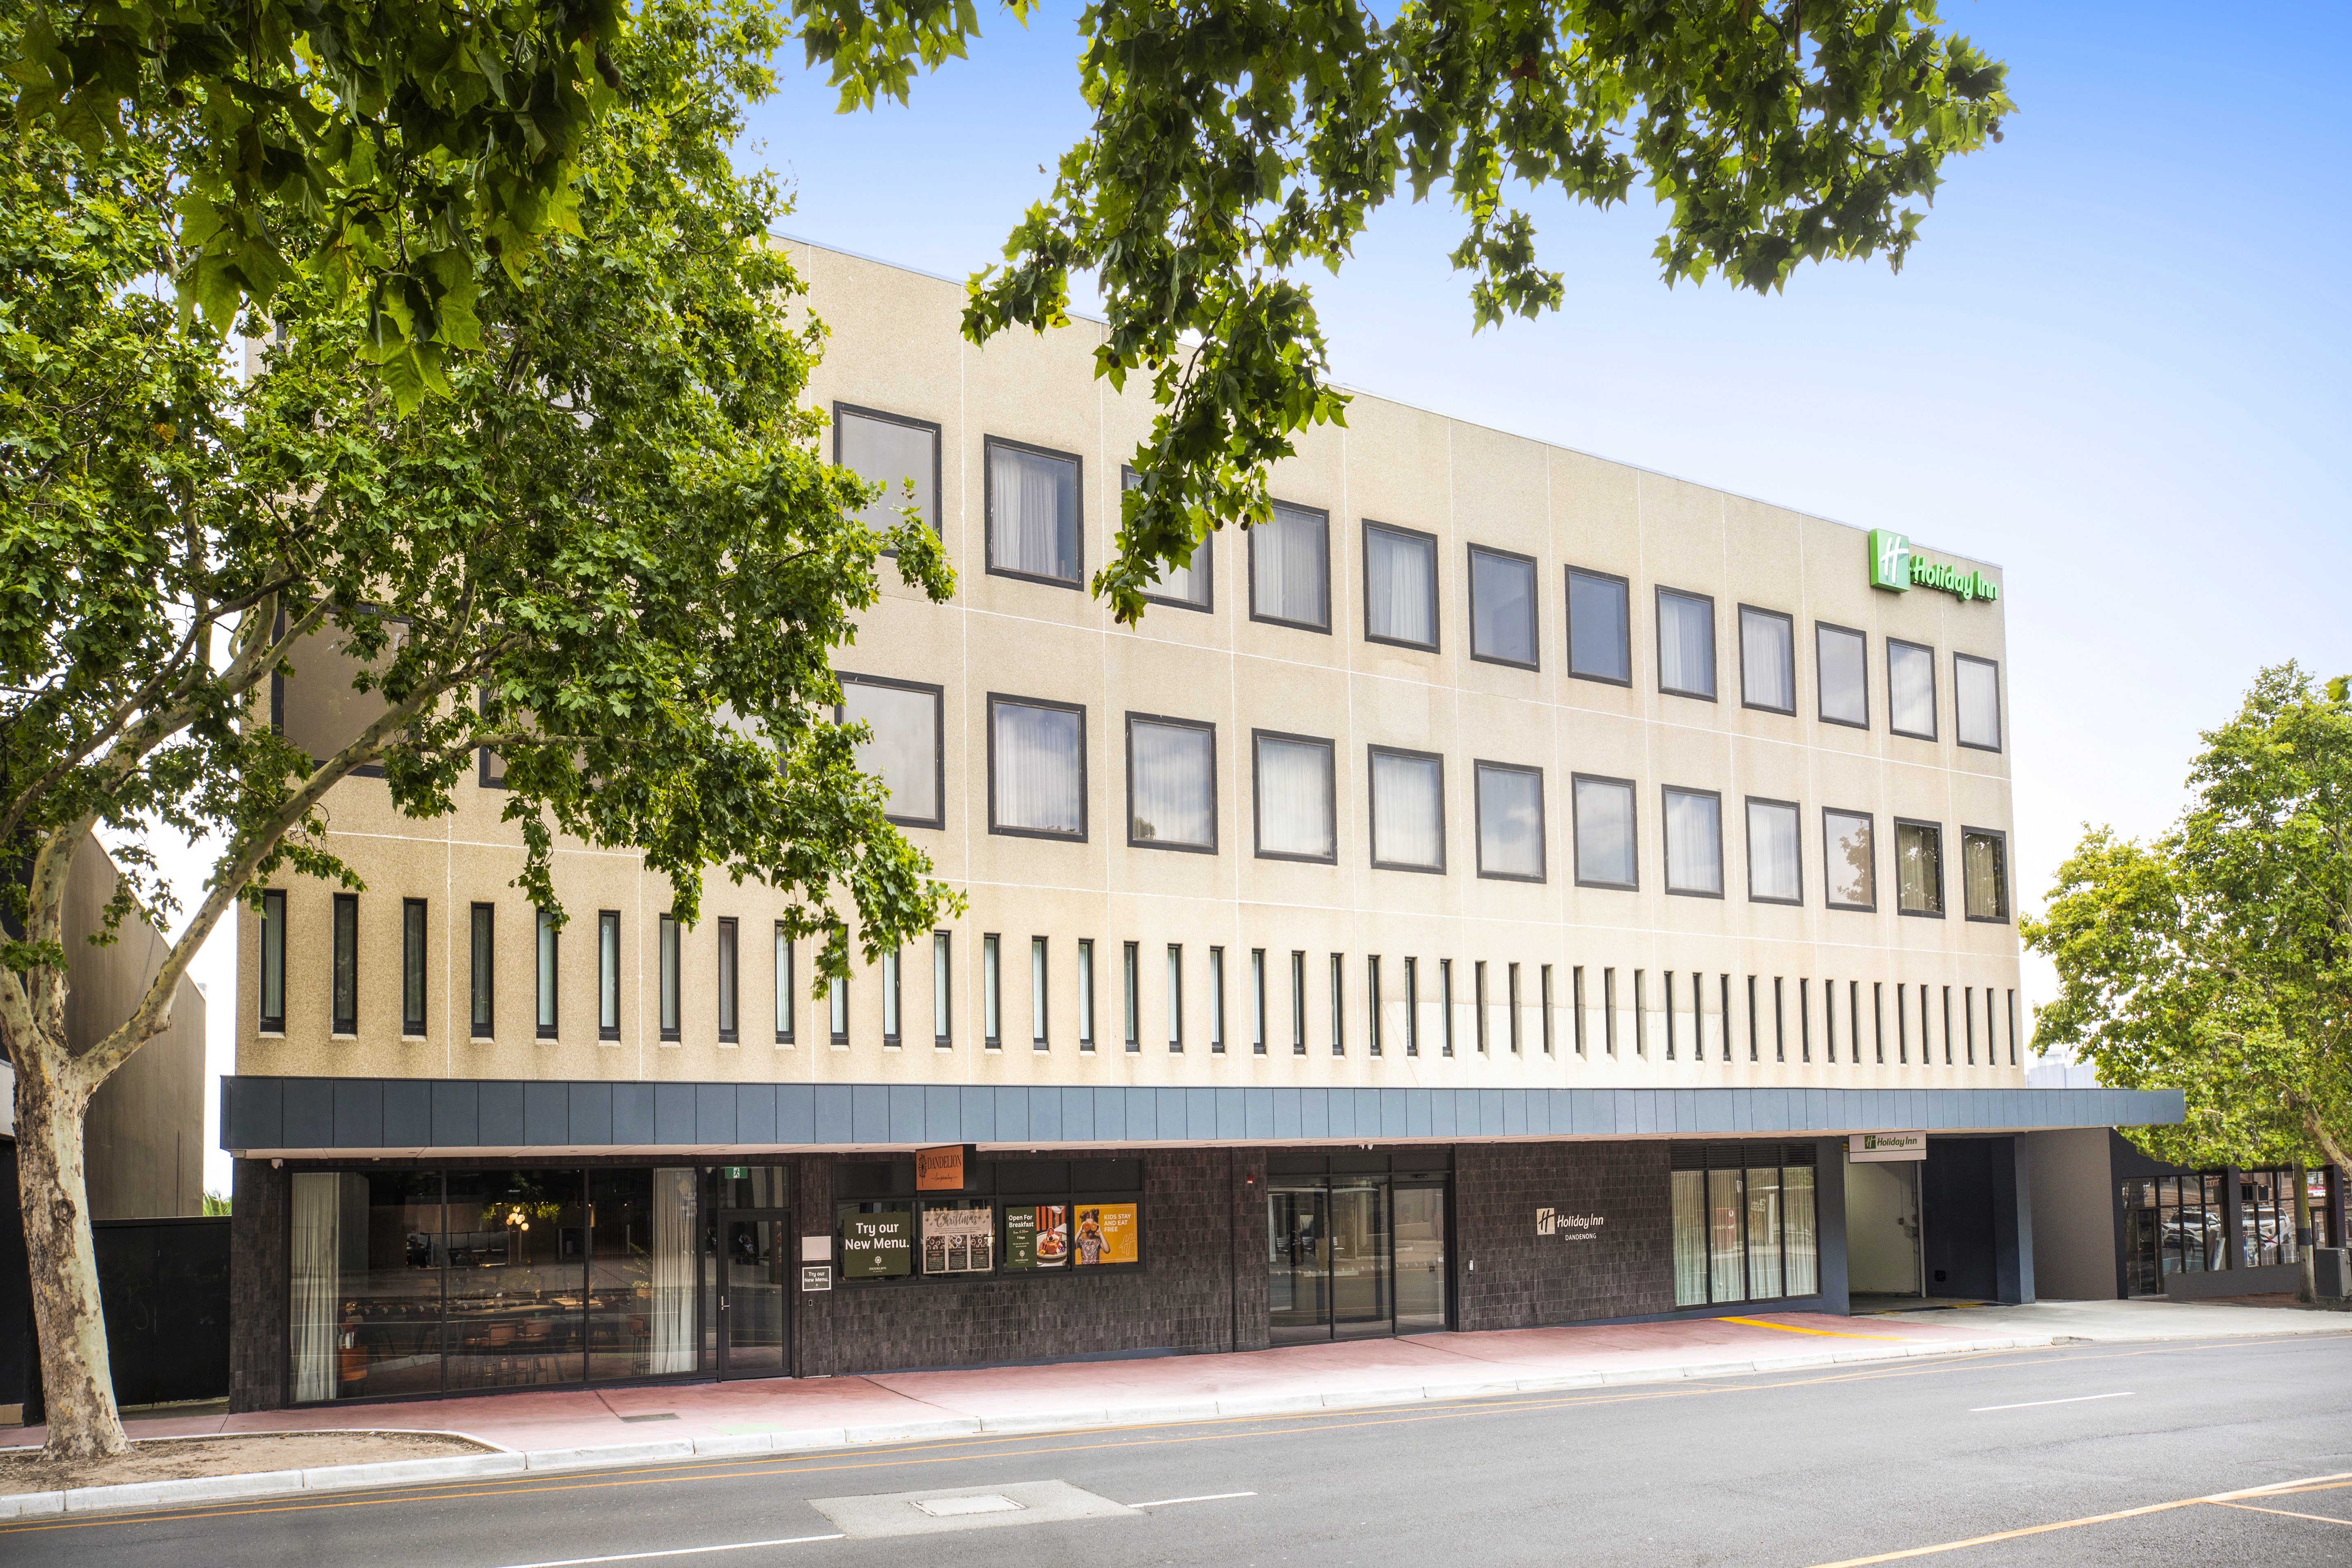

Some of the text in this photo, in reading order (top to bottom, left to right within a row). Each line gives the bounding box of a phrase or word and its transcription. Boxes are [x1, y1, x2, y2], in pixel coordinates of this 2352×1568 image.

[1912, 555, 1974, 600] Holiday
[1976, 570, 1999, 601] Inn
[1877, 1137, 1904, 1147] Holiday
[1905, 1136, 1917, 1145] Inn
[927, 1154, 961, 1169] DANDELION
[936, 1212, 977, 1227] Christmas
[1557, 1214, 1589, 1229] Holiday
[1590, 1213, 1604, 1225] Inn
[856, 1223, 899, 1236] Try our
[845, 1238, 909, 1250] New Menu.
[1565, 1233, 1596, 1241] DANDENONG
